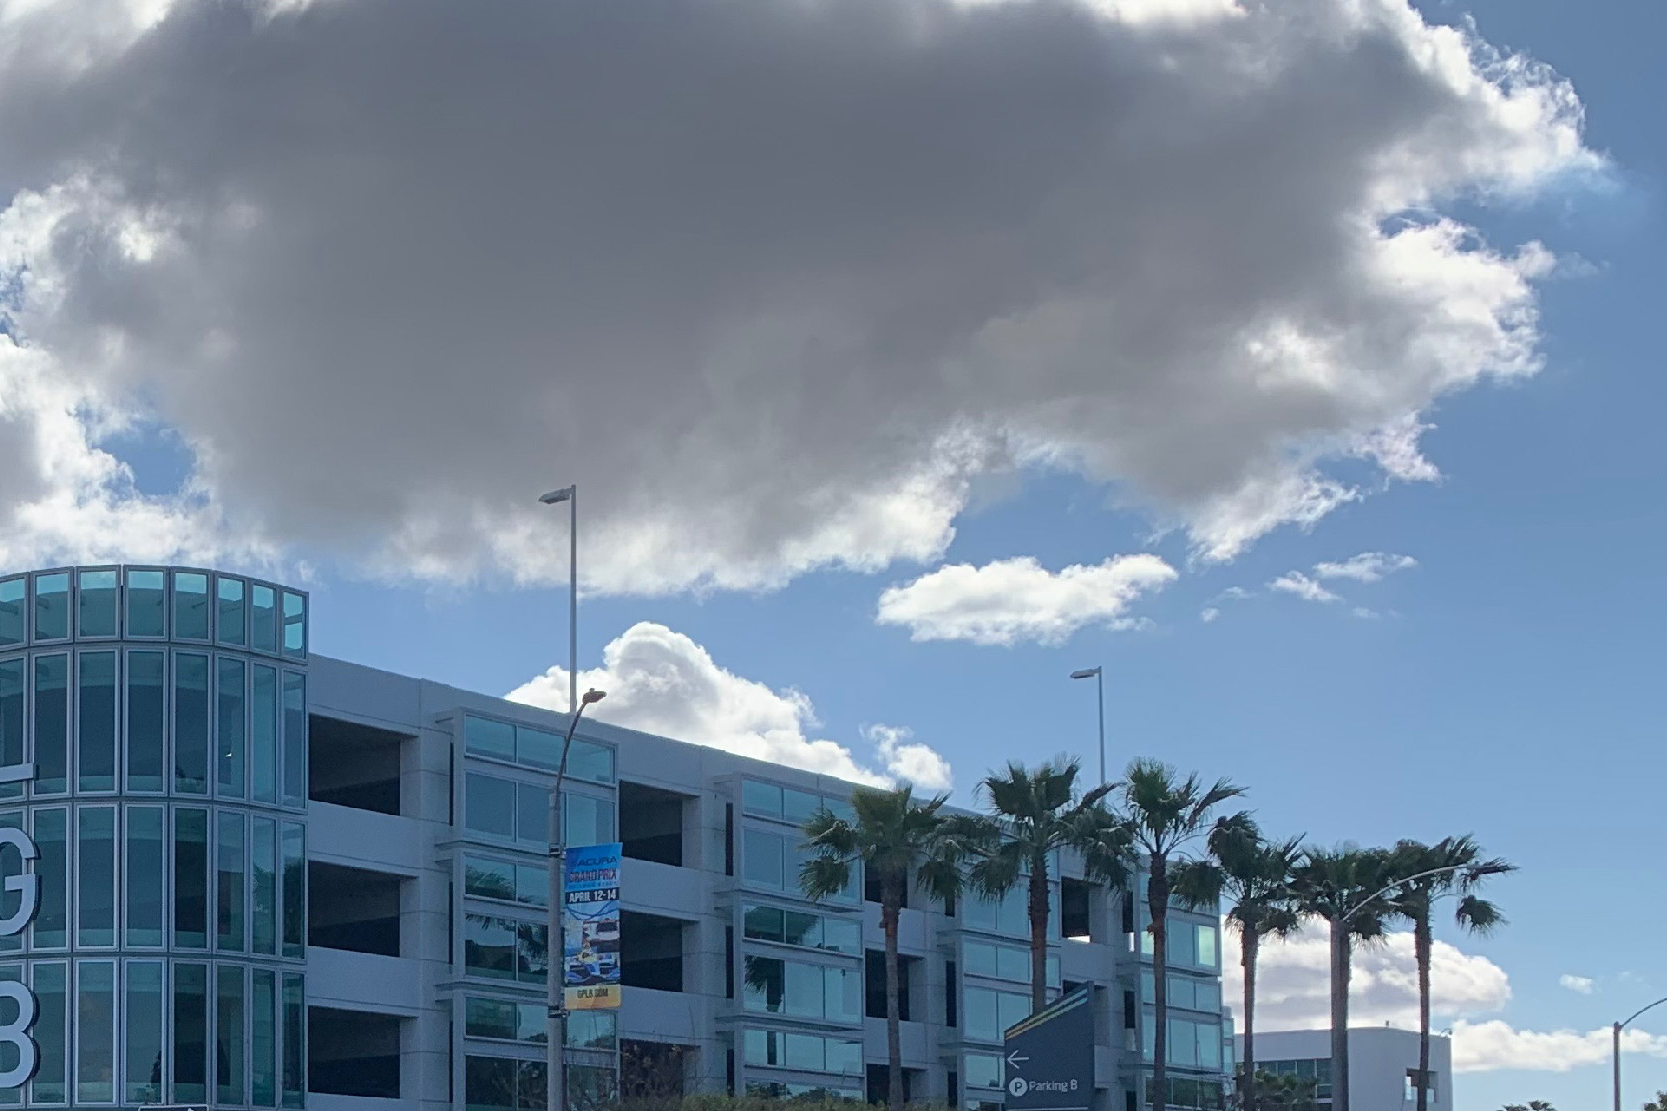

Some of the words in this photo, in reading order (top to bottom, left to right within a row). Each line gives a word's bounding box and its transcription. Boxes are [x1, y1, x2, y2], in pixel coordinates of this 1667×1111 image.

[569, 892, 591, 902] APRIL
[594, 889, 616, 900] 12-14
[1029, 1081, 1068, 1092] Parking
[1070, 1079, 1078, 1090] B
